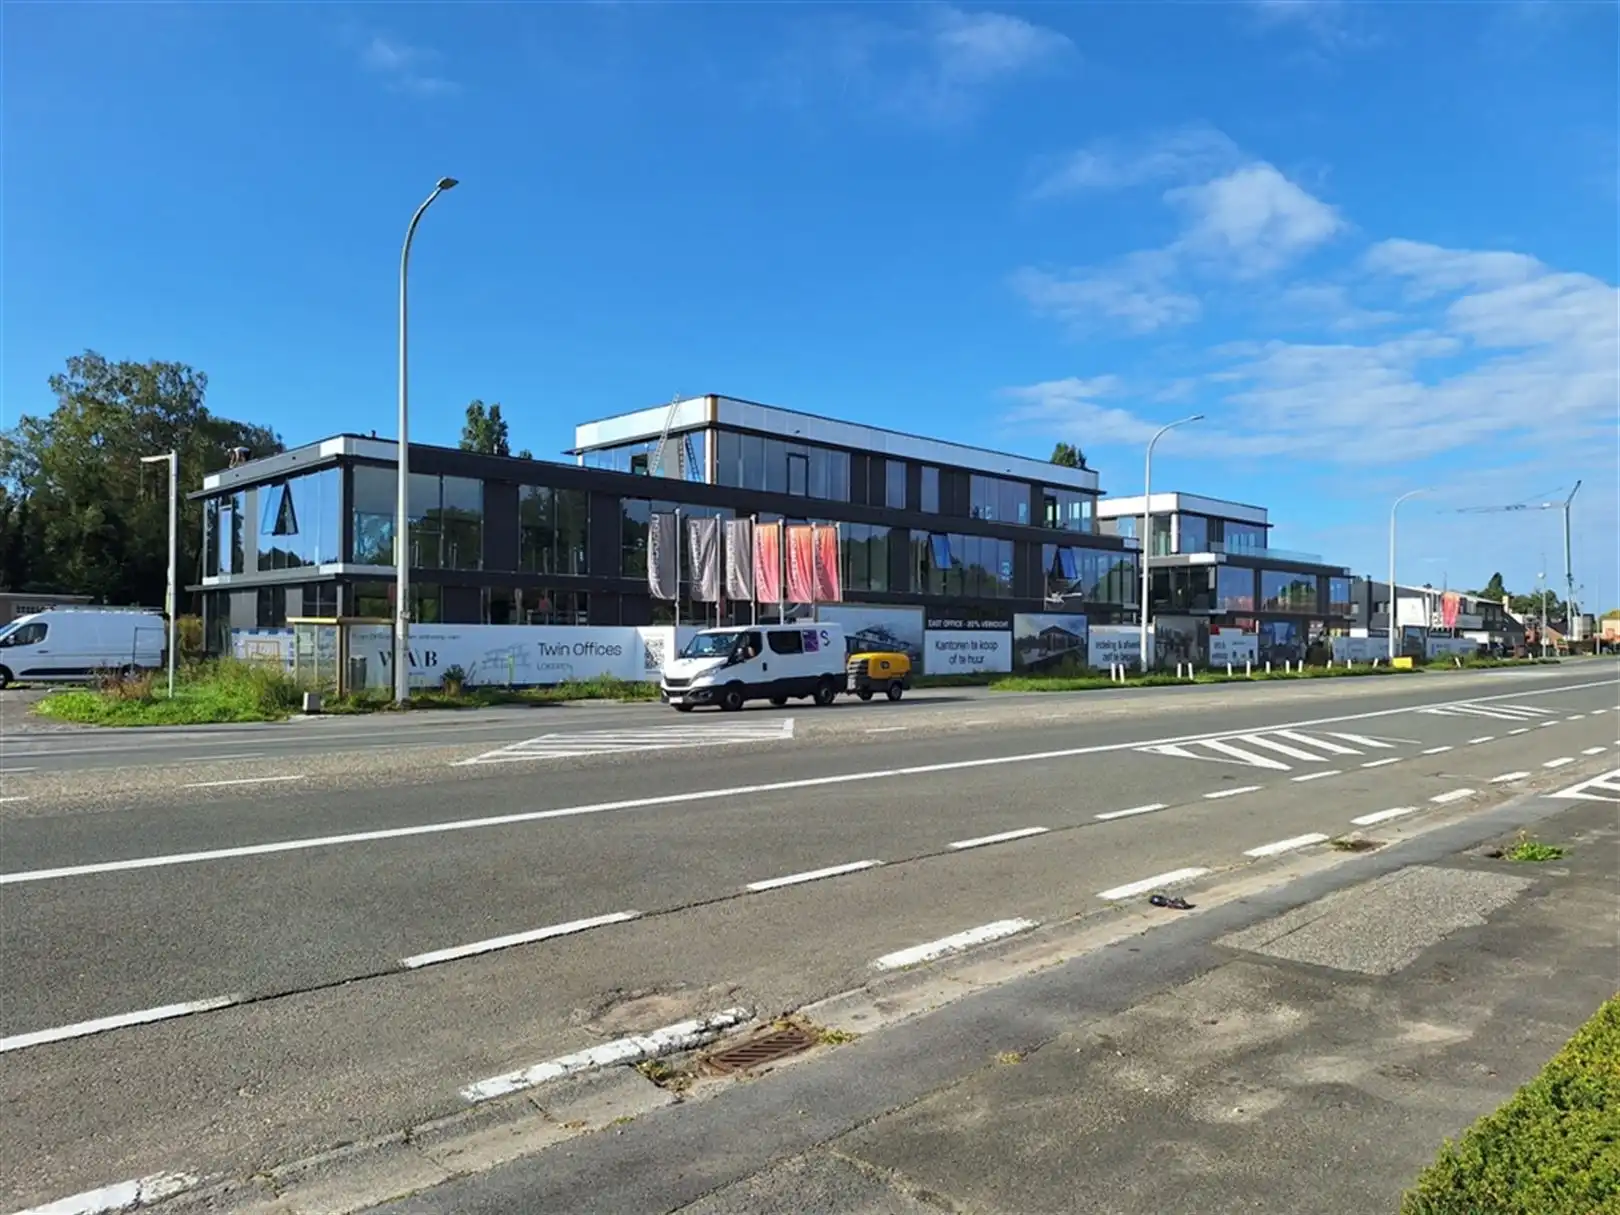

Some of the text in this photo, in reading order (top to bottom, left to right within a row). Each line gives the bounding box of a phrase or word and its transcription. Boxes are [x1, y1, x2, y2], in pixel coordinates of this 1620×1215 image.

[537, 642, 622, 656] Twin Offices
[979, 640, 998, 652] koop
[968, 654, 984, 664] huur
